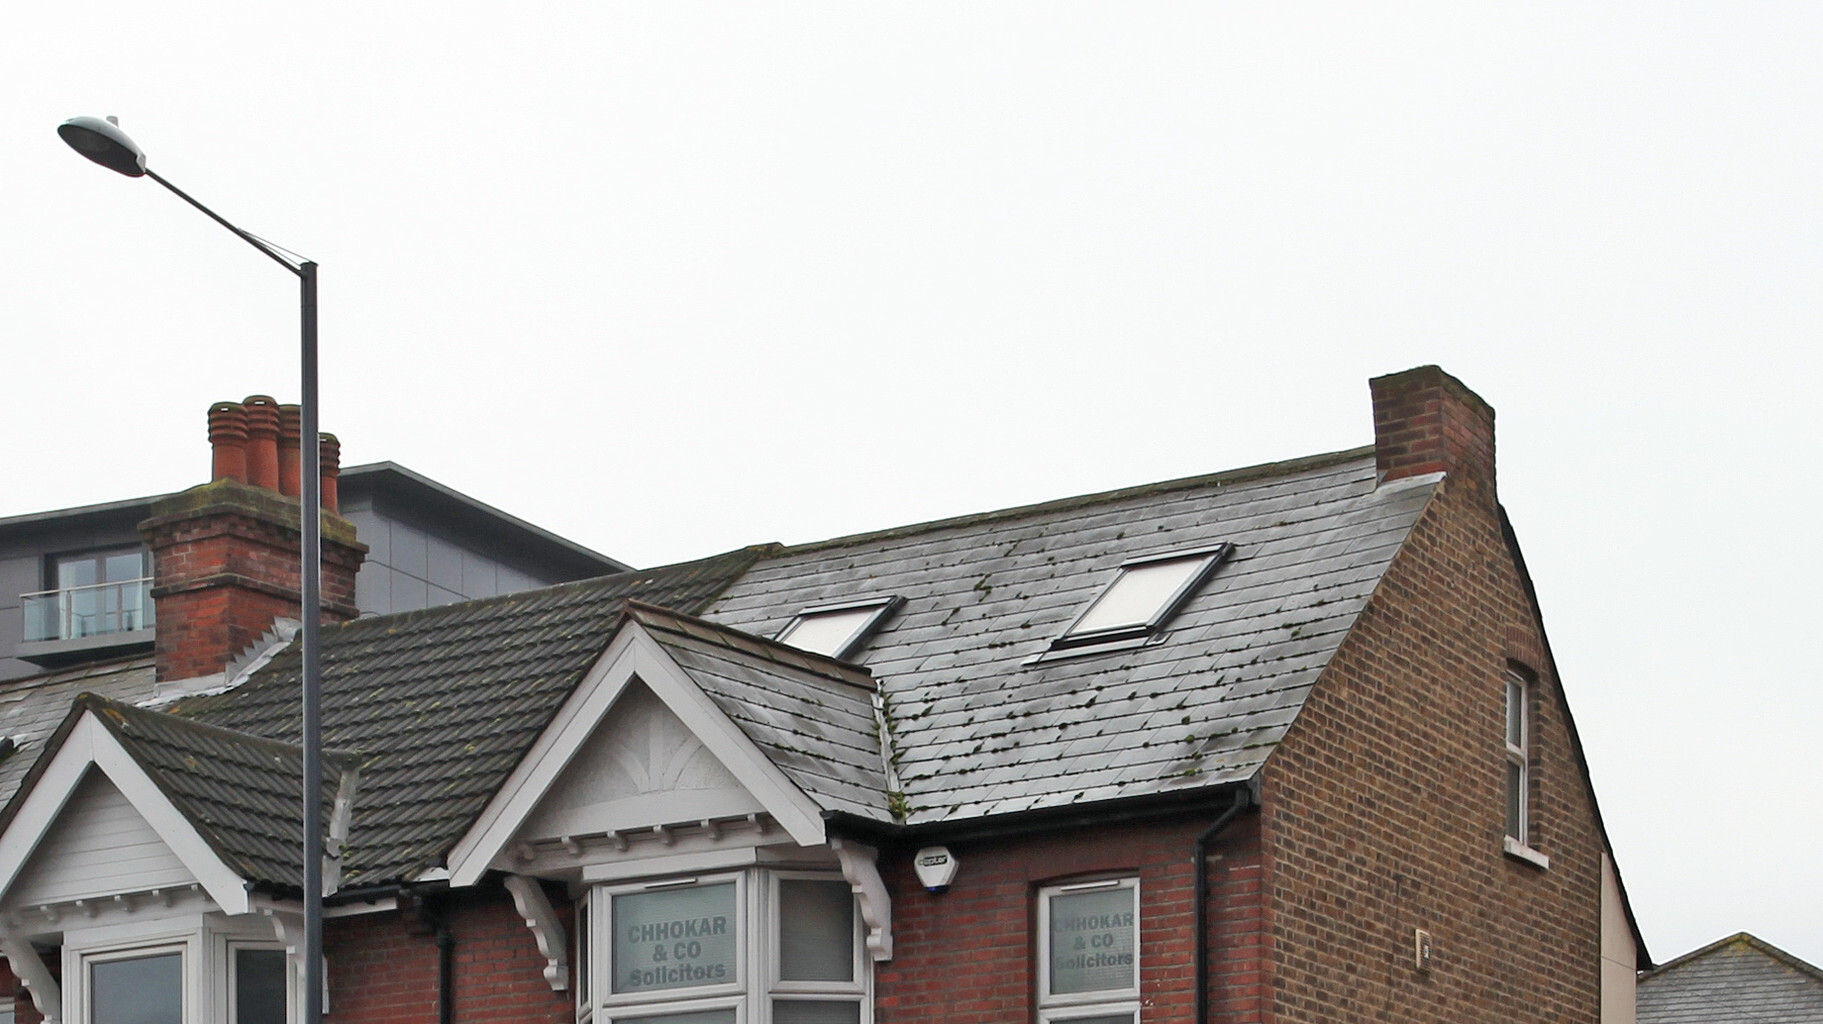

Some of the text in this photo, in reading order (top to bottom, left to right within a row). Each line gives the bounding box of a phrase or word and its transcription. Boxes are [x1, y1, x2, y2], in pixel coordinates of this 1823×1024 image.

[627, 916, 727, 943] CHHOKAR
[653, 941, 702, 962] & CO
[1073, 933, 1114, 950] & CO
[1055, 953, 1134, 970] Solicitors
[630, 963, 726, 986] Solicitors
